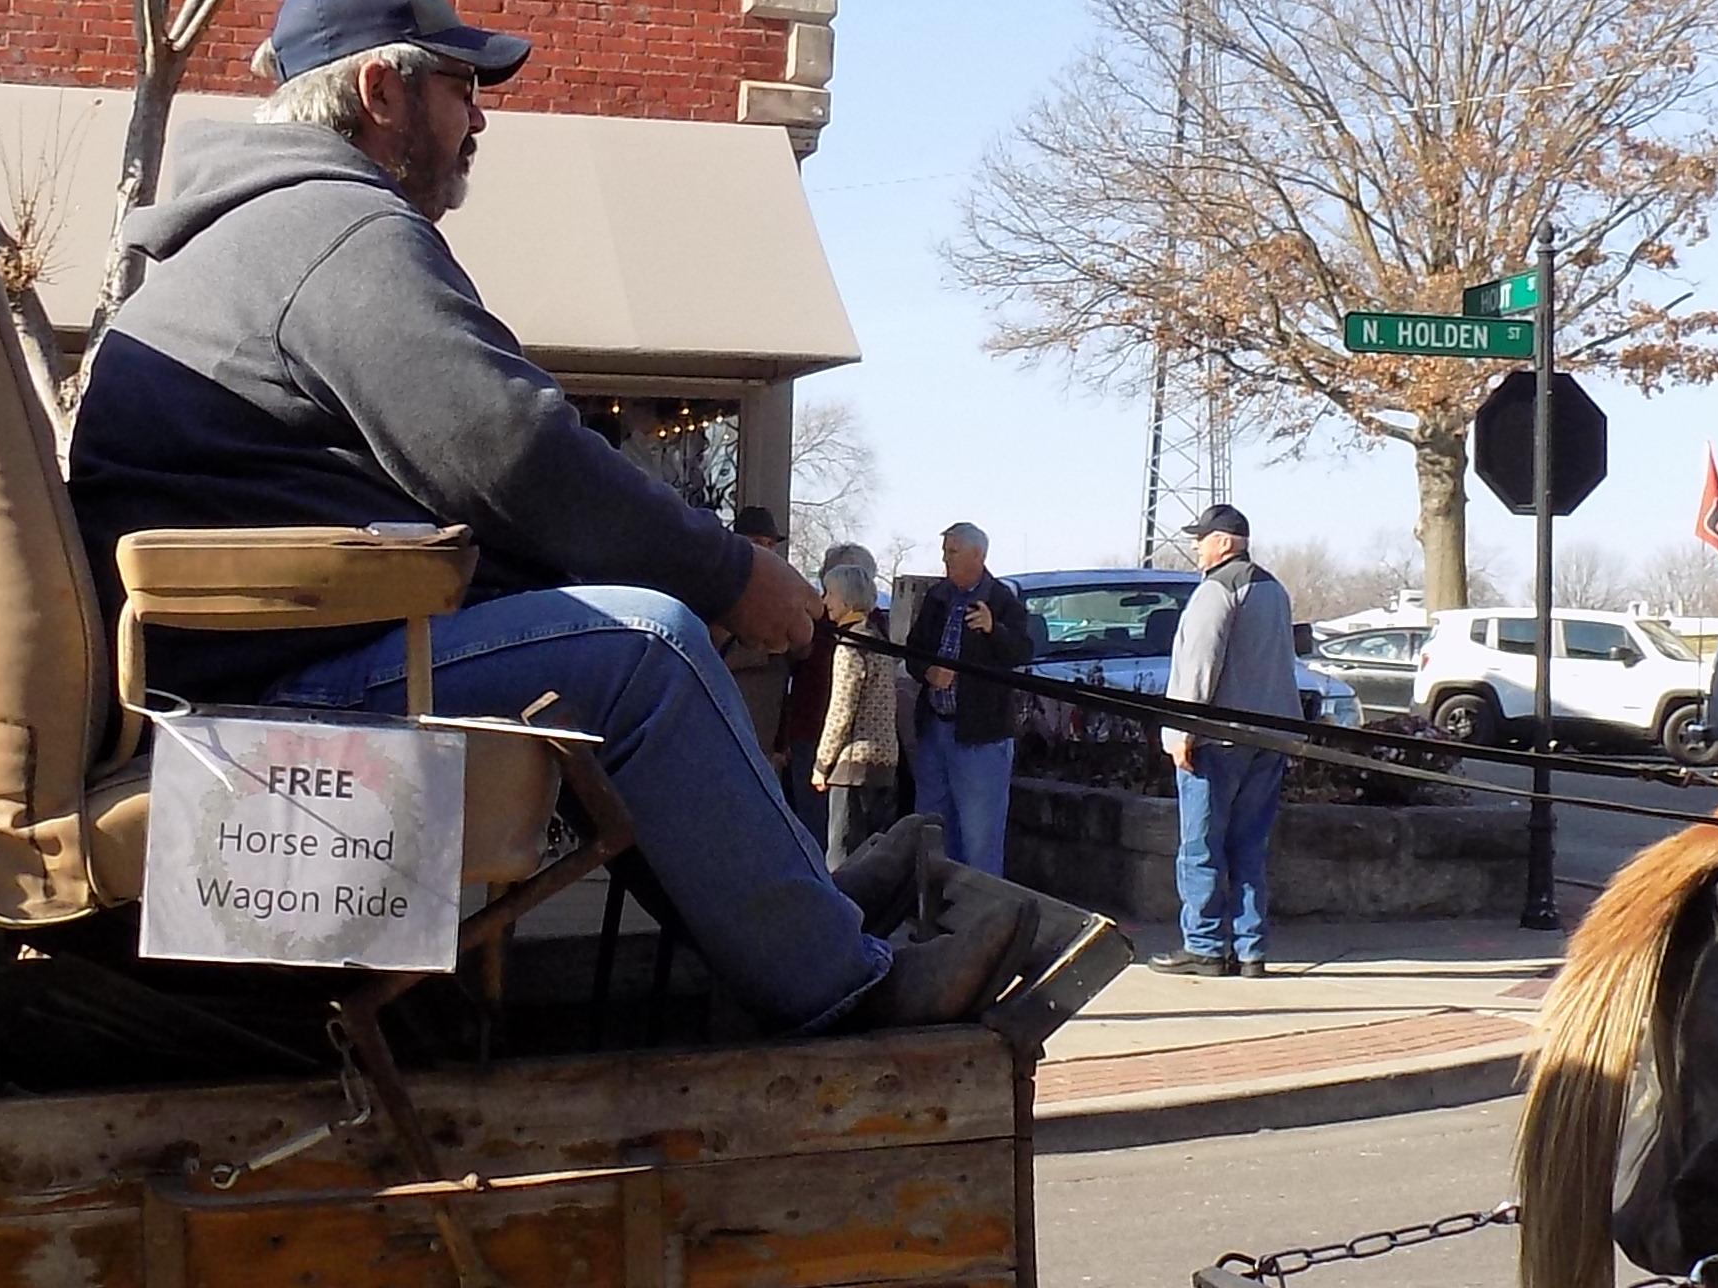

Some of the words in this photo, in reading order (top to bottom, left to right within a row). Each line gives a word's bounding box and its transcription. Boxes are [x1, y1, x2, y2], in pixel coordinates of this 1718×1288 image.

[1527, 276, 1537, 292] S
[1362, 320, 1384, 345] N.
[1398, 323, 1489, 350] HOLDEN
[1507, 326, 1522, 340] ST
[267, 765, 354, 800] FREE
[217, 821, 319, 857] Horse
[331, 831, 395, 861] and
[195, 877, 320, 920] Wagon
[334, 885, 409, 919] Ride
